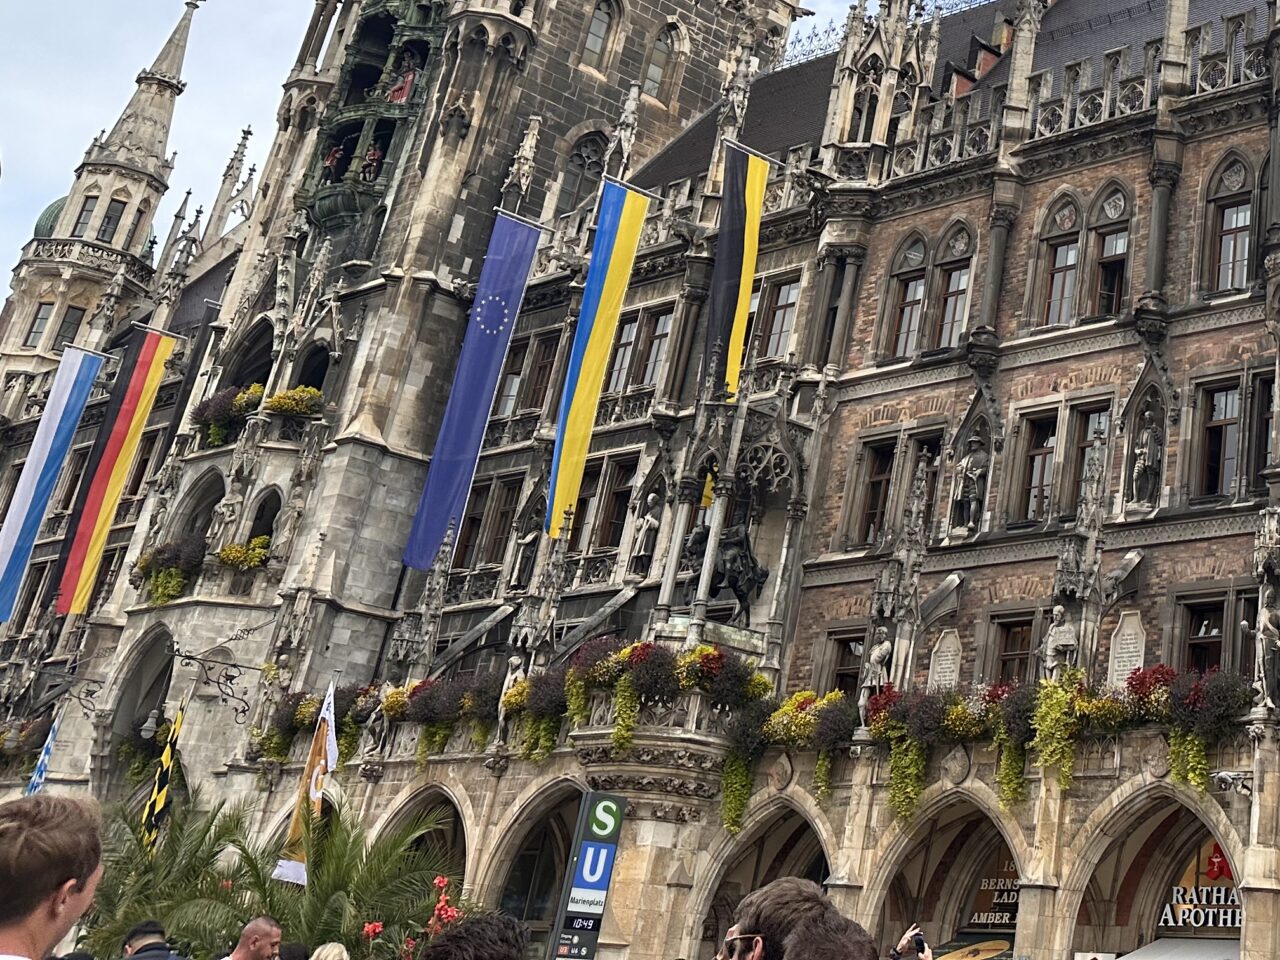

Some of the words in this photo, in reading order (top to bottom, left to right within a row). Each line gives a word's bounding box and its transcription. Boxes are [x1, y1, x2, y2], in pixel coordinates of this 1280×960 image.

[591, 800, 617, 836] S
[582, 847, 607, 883] U
[569, 896, 604, 907] Marienplatz
[572, 918, 594, 930] 10:49
[970, 912, 1010, 924] AMBER
